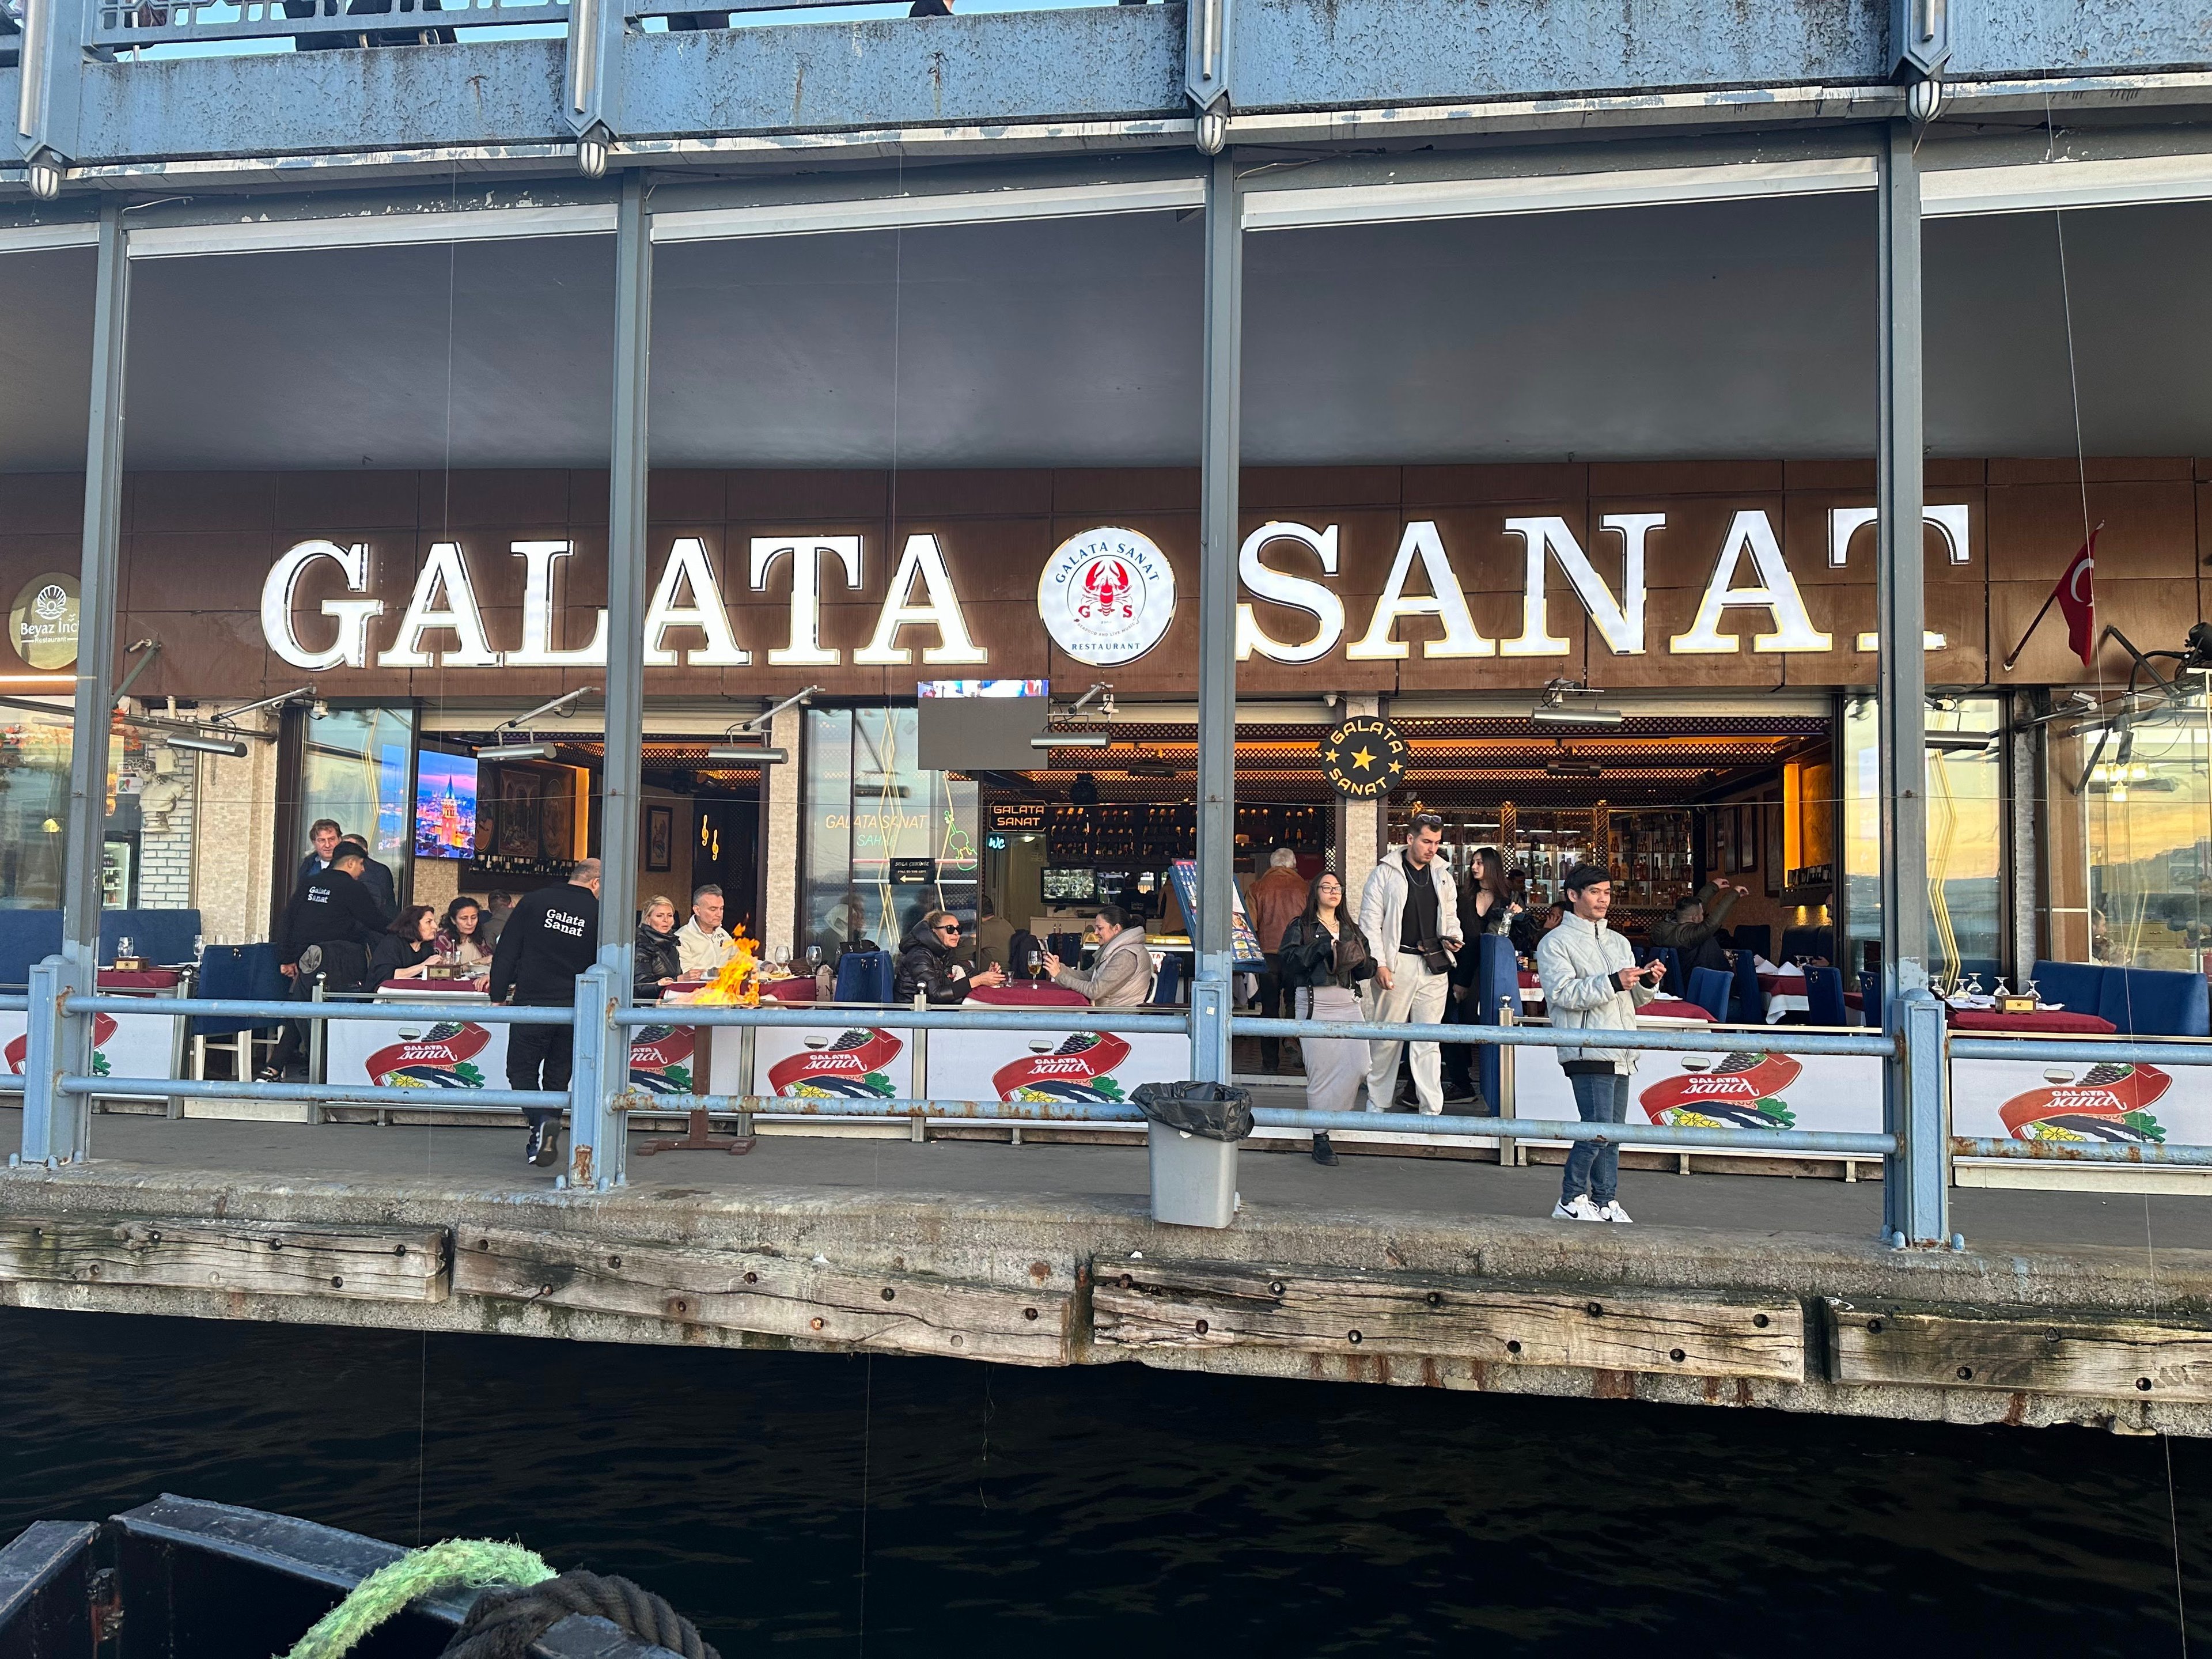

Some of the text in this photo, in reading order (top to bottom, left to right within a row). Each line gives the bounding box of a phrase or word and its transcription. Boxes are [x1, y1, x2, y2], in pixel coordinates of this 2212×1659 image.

[1056, 542, 1159, 583] GALATA SANAT
[261, 504, 1971, 671] GALATA SANAT
[1123, 605, 1132, 618] S
[21, 623, 55, 637] Beyaz
[1330, 719, 1404, 754] GALATA
[1328, 768, 1387, 796] SANAT
[994, 805, 1044, 814] GALATA
[825, 815, 928, 829] GALATA SANAT
[997, 817, 1040, 826] SANAT
[988, 836, 1006, 849] WC
[308, 893, 328, 903] Sanat
[309, 886, 331, 895] Galata
[547, 909, 585, 927] Galata
[544, 918, 583, 937] Sanat
[396, 1045, 458, 1062] sanat
[802, 1054, 868, 1071] sanat
[1027, 1058, 1095, 1075] sanat
[1680, 1077, 1760, 1097] sanat
[2042, 1090, 2127, 1111] sanat
